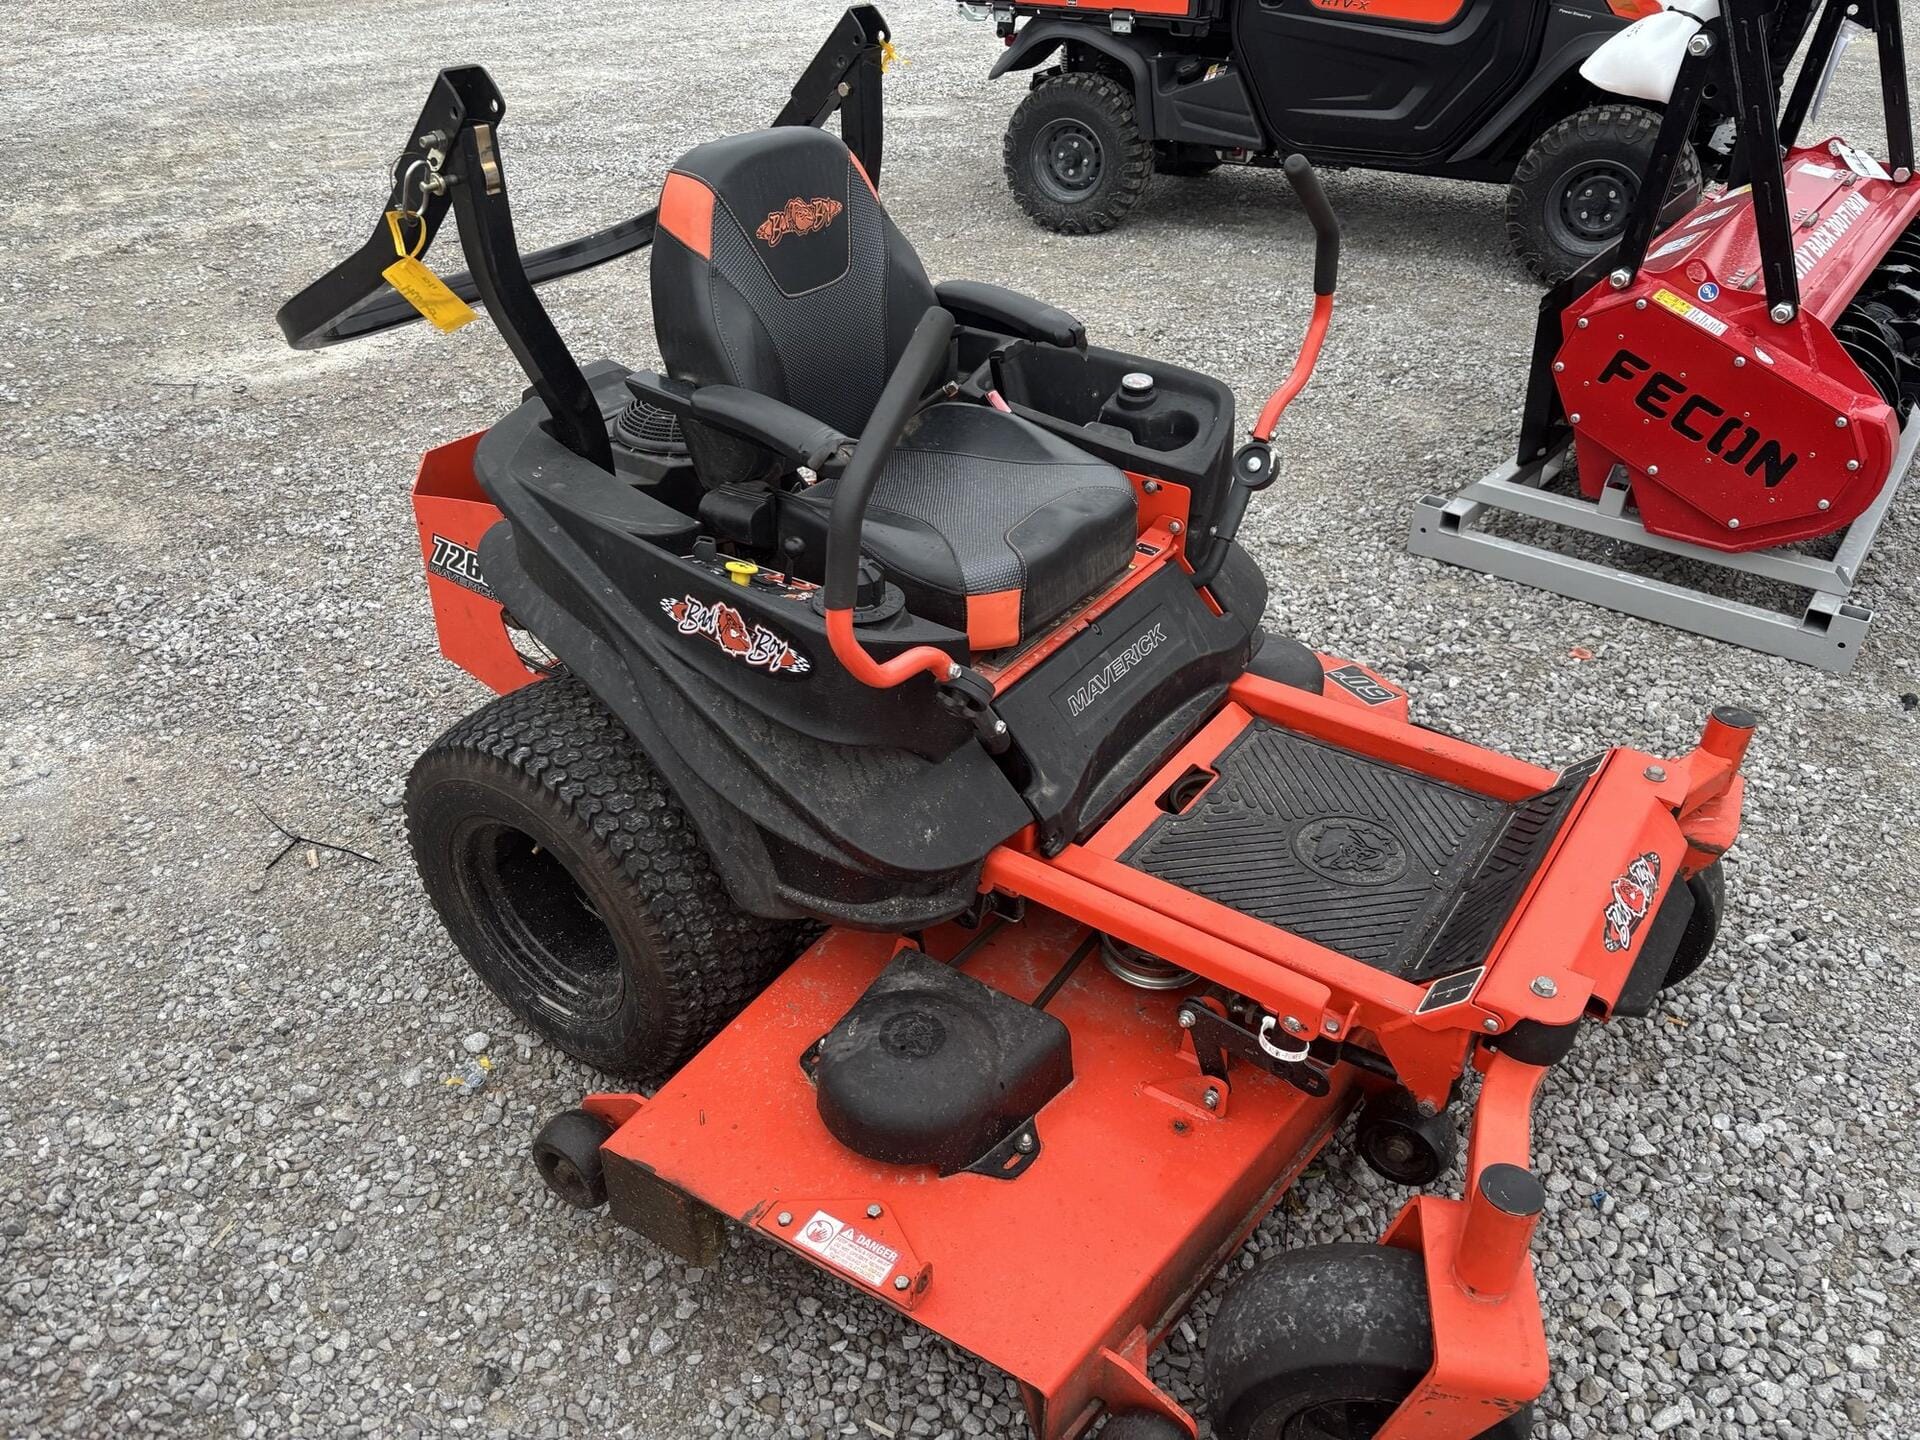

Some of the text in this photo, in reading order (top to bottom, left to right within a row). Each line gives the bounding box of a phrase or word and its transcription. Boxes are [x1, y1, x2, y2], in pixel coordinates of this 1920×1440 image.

[1804, 226, 1835, 259] BACK
[1597, 349, 1798, 488] FECON
[679, 595, 791, 671] Bad Boy
[1067, 622, 1167, 716] MAVERICK
[857, 1234, 898, 1262] DANGER
